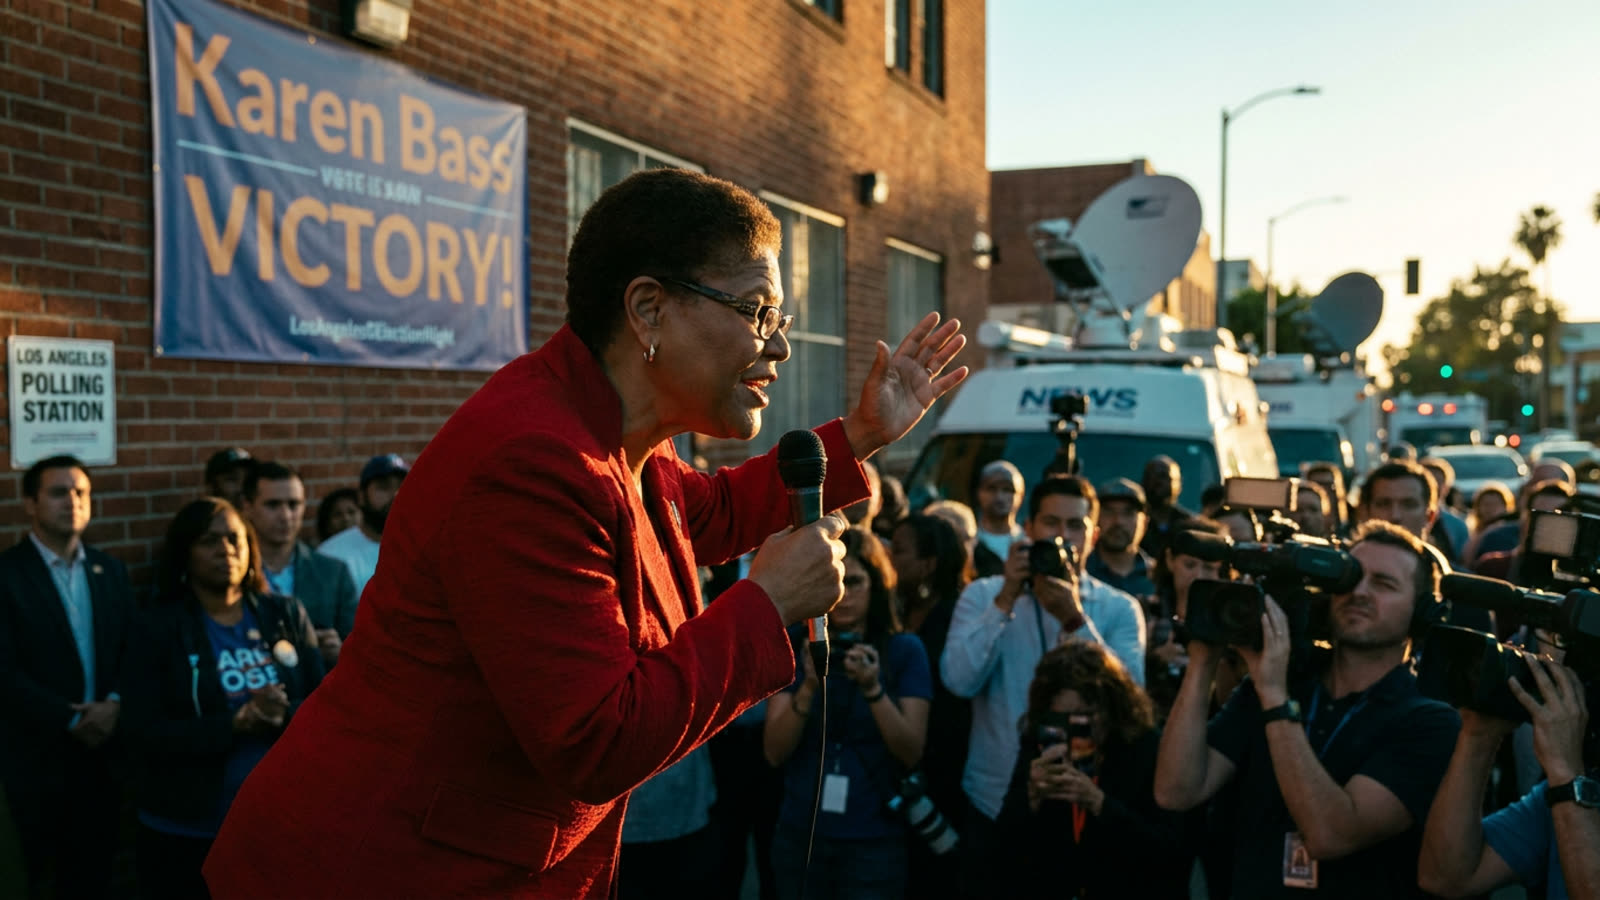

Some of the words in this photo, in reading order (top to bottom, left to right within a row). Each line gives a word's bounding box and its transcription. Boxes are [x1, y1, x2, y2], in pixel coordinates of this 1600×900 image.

[174, 21, 385, 165] Karen
[400, 93, 513, 195] Bass
[183, 173, 513, 309] VICTORY!
[16, 348, 42, 365] LOS
[48, 349, 107, 367] ANGELES
[21, 372, 105, 395] POLLING
[1019, 387, 1138, 411] NWS
[23, 401, 104, 423] STATION
